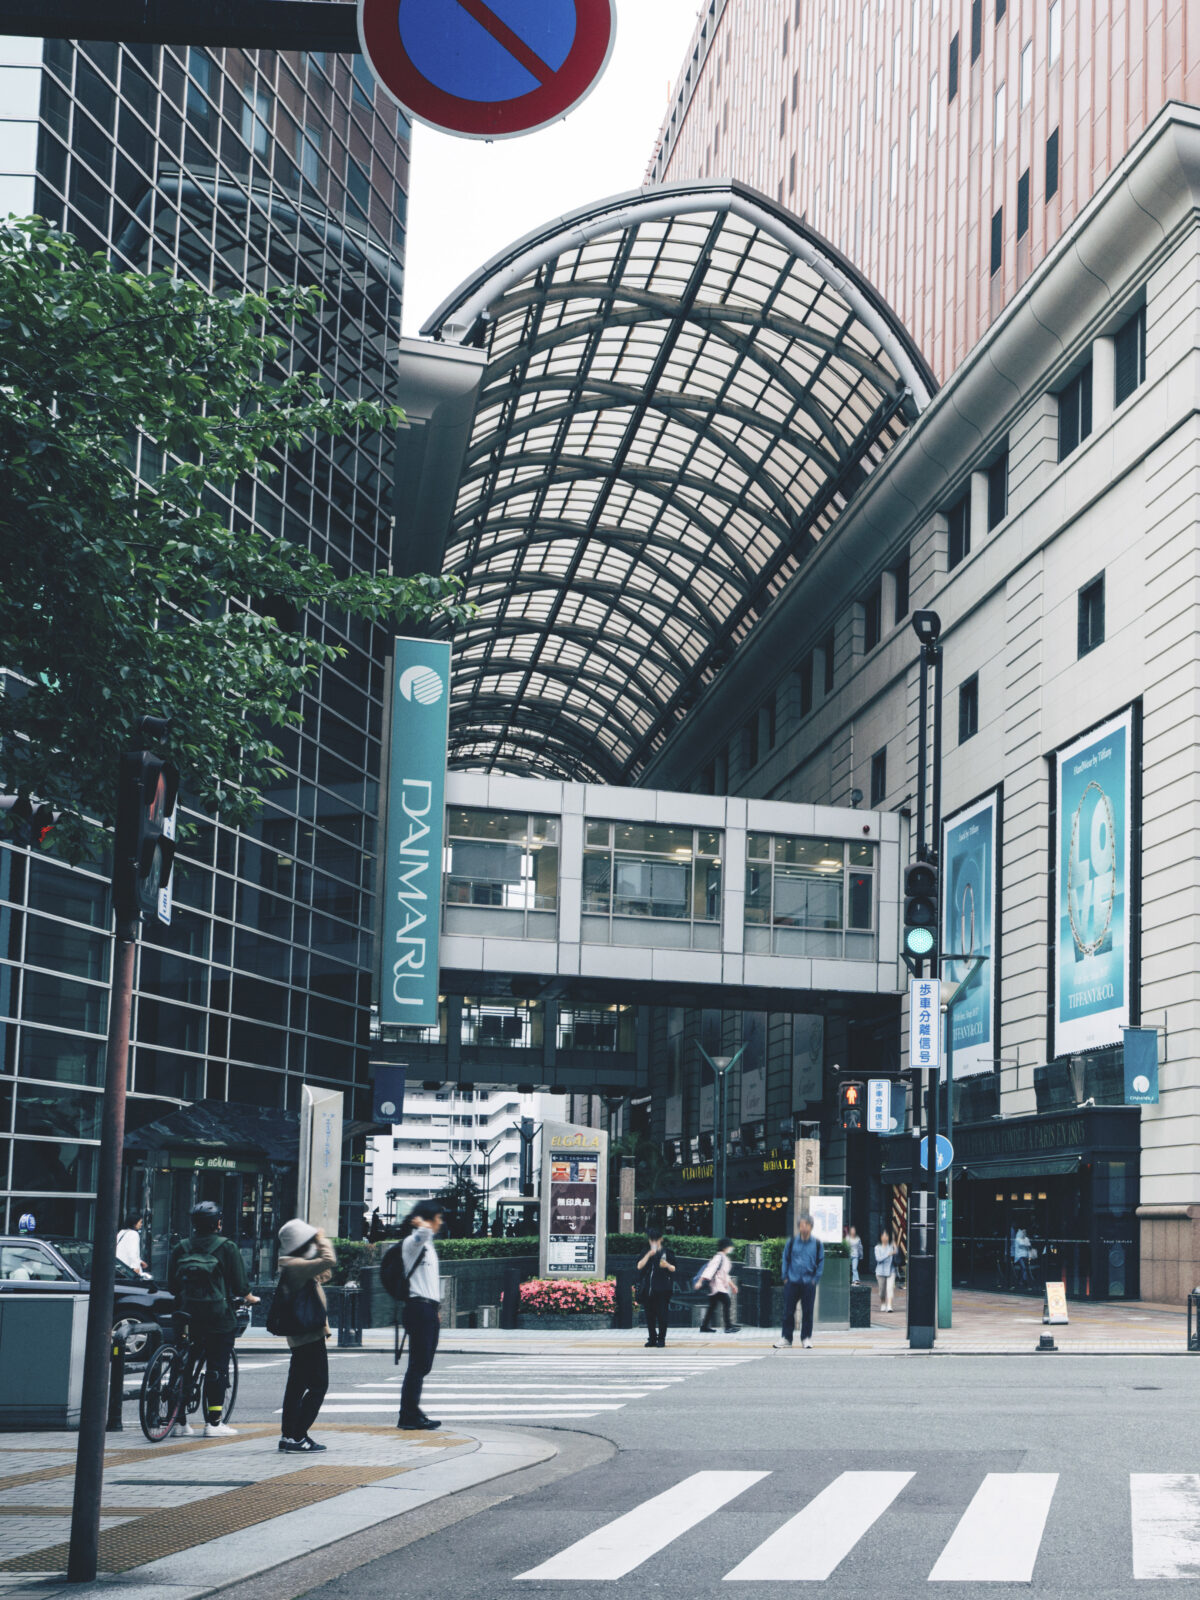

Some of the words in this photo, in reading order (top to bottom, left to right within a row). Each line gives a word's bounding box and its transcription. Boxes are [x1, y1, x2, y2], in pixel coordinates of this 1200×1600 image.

[393, 778, 432, 1005] DAIMARU
[919, 983, 931, 1063] 歩車分離信号
[874, 1083, 883, 1129] 歩車分離信号
